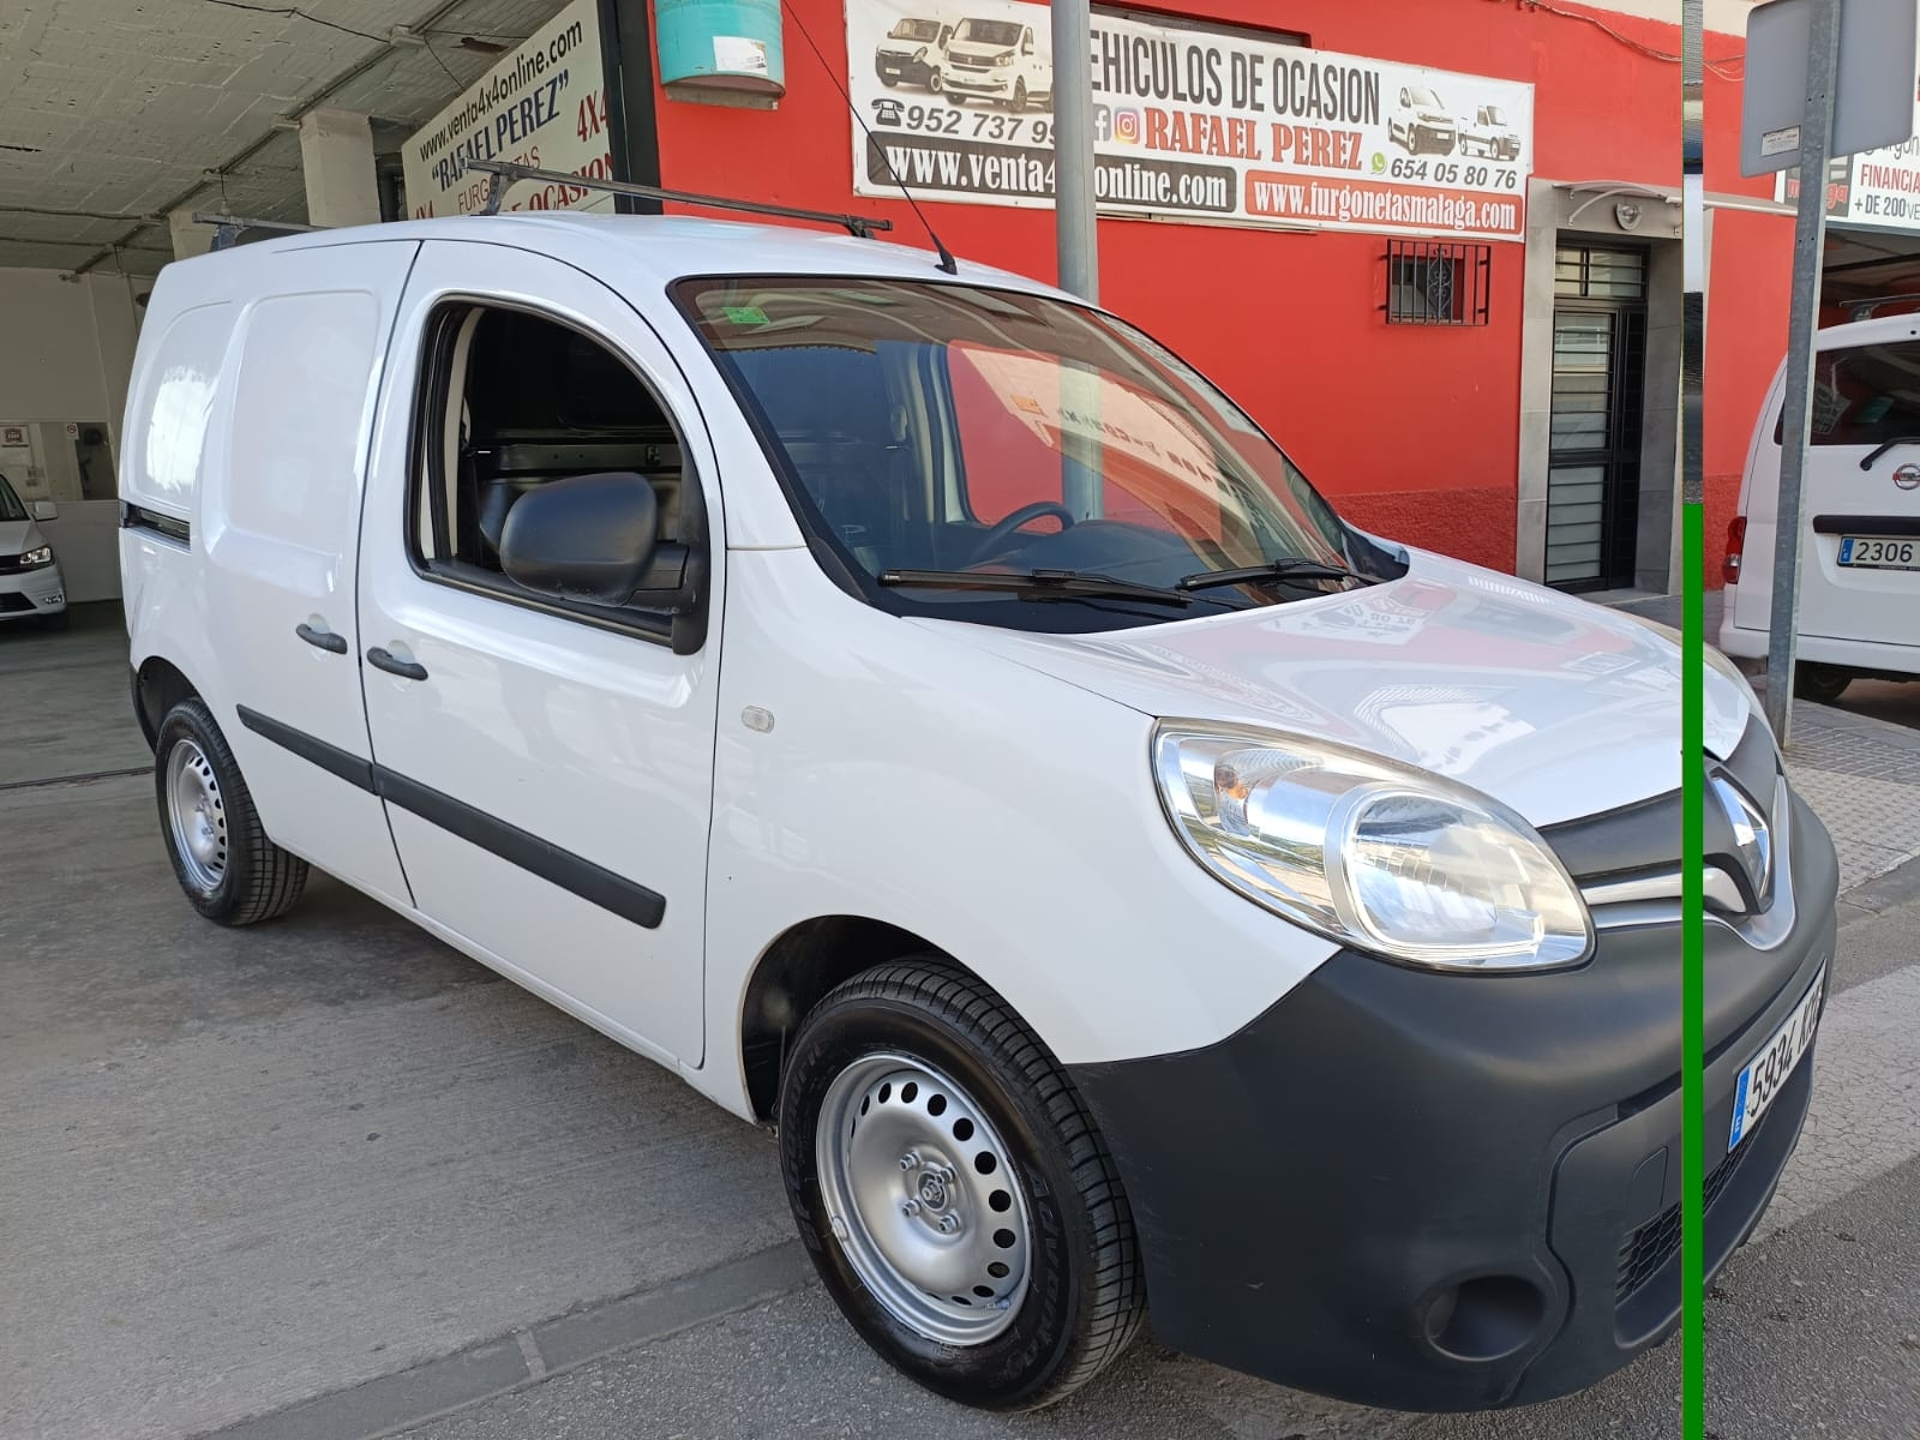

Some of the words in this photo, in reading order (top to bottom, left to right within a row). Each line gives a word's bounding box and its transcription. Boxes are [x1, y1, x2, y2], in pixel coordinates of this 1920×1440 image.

[419, 20, 582, 162] www.venta4x4online.com
[1091, 29, 1222, 107] EHICULOS
[1231, 51, 1265, 113] DE
[1273, 57, 1380, 126] OCASION
[906, 105, 962, 134] 952
[972, 112, 1023, 142] 737
[1145, 106, 1261, 162] RAFAEL
[1271, 122, 1363, 171] PEREZ
[885, 146, 1227, 207] www.venta4online.com
[1391, 158, 1428, 181] 654
[1434, 162, 1459, 184] 05
[1464, 165, 1488, 187] 80
[1494, 169, 1517, 189] 76
[1254, 182, 1516, 230] www.furgonetasmalaga.com
[1865, 194, 1881, 214] DE
[1883, 196, 1907, 218] 200
[1855, 541, 1914, 563] 2306
[1748, 1019, 1797, 1118] 5934
